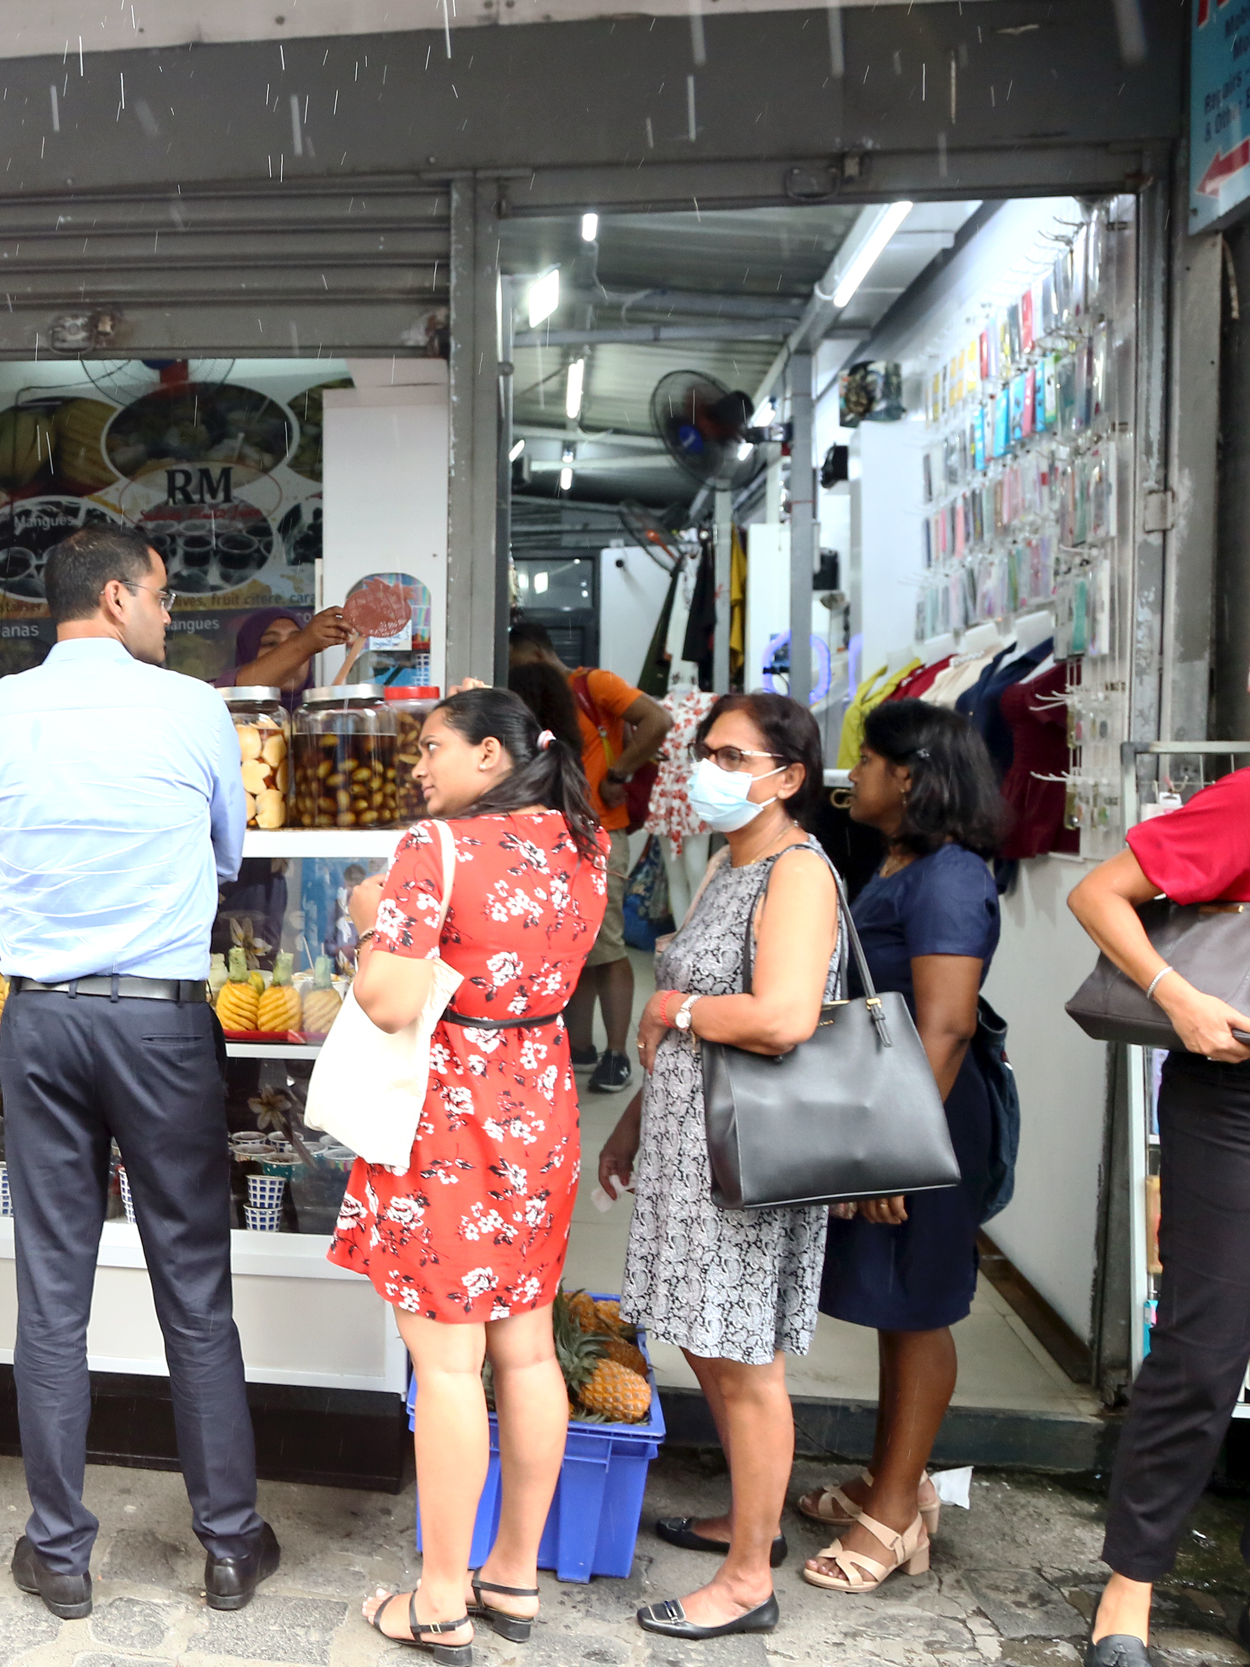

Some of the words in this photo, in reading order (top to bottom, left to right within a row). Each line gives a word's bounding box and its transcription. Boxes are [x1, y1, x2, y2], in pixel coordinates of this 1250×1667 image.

[165, 466, 234, 506] RM
[14, 515, 73, 531] Mangues
[166, 618, 220, 634] angues
